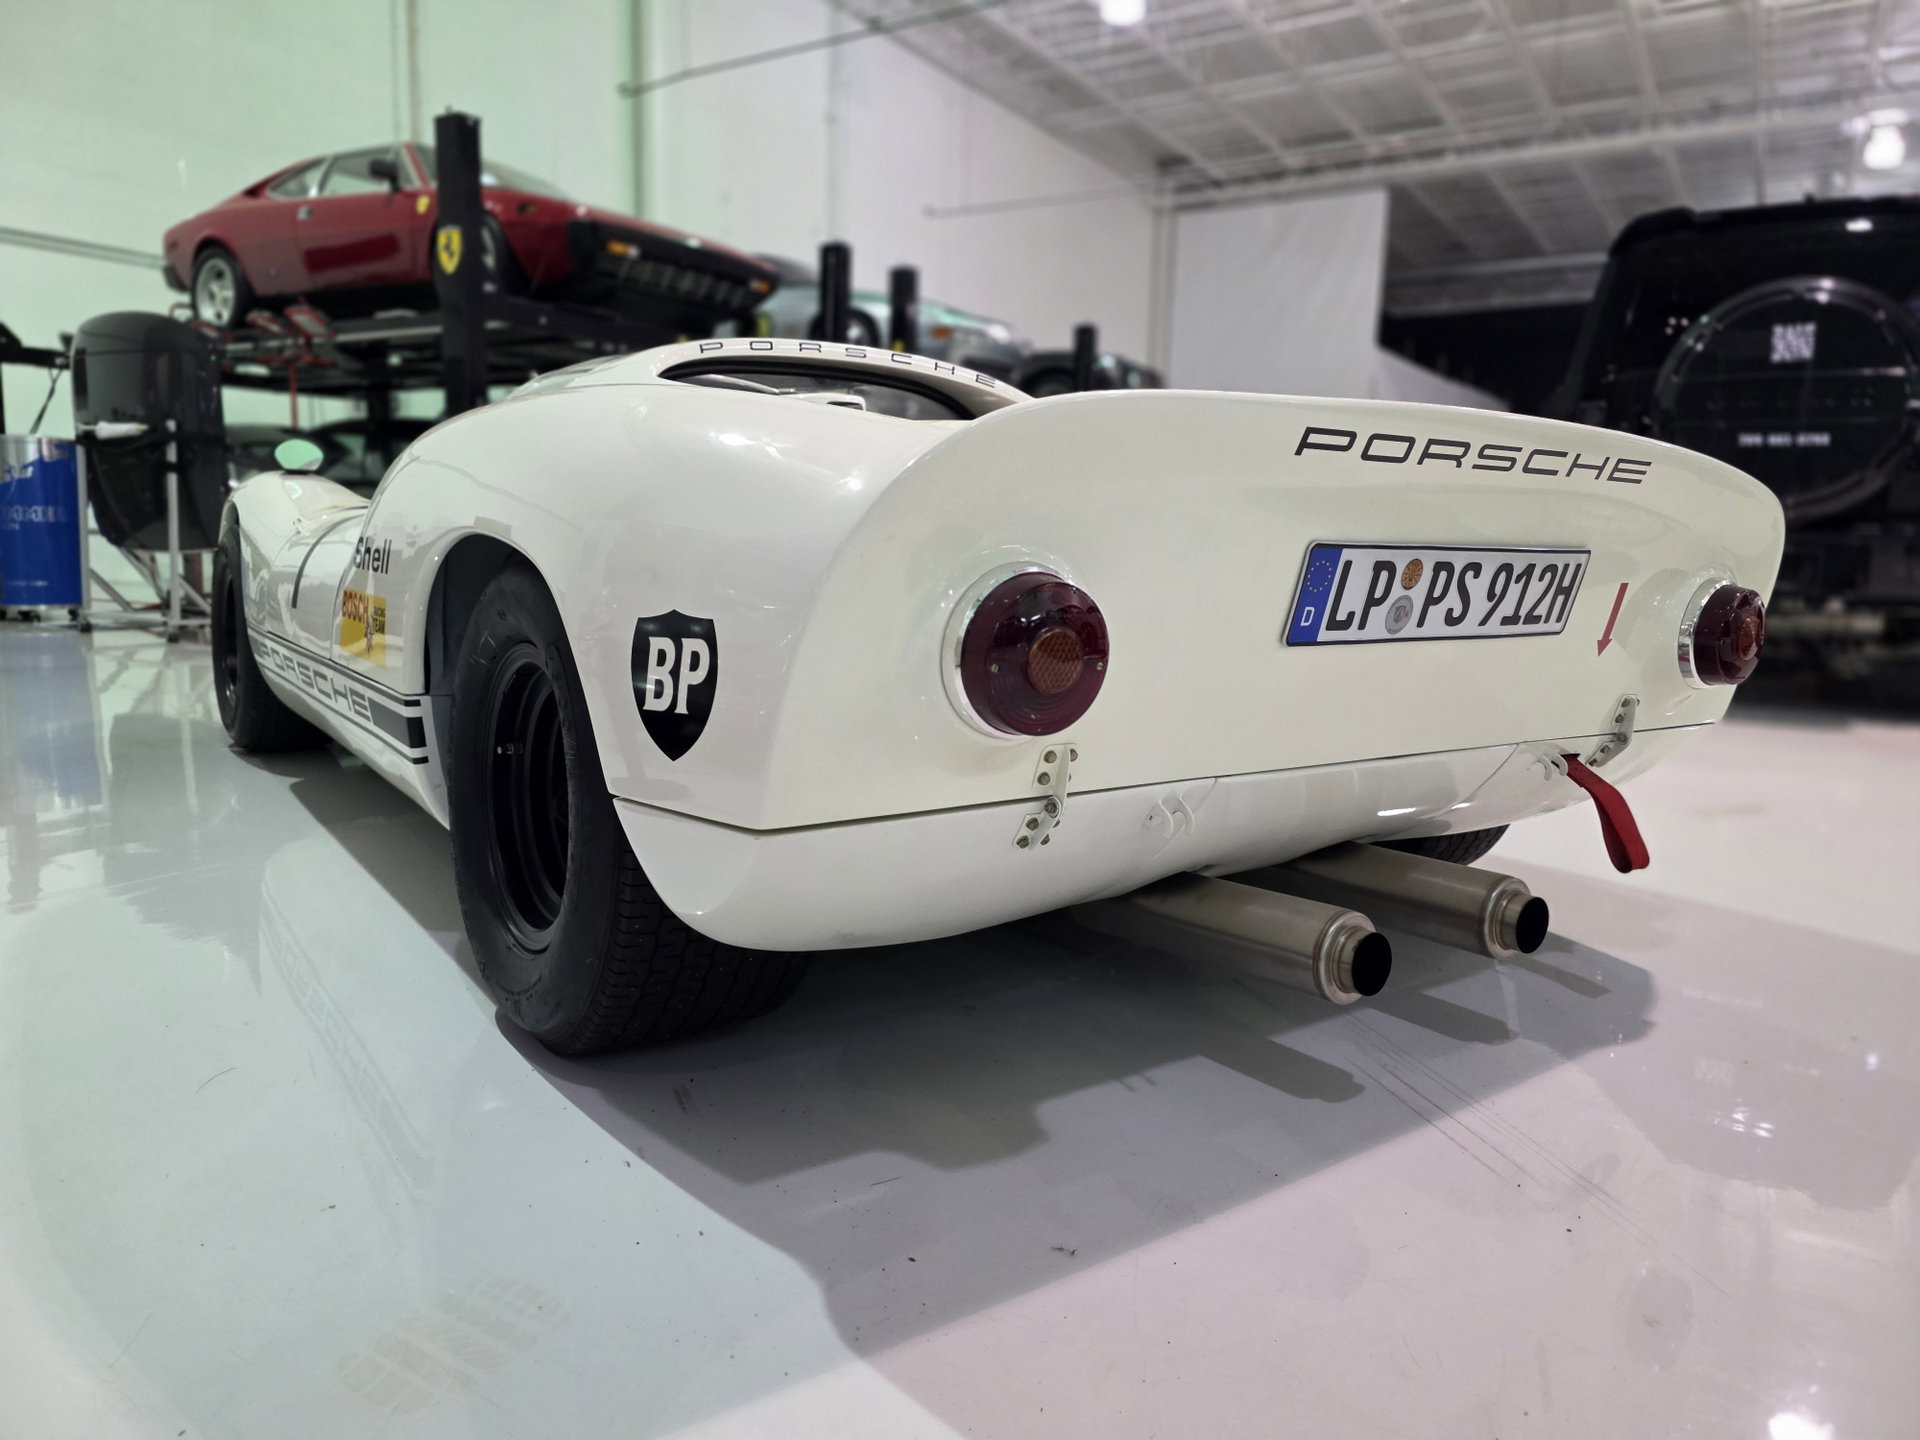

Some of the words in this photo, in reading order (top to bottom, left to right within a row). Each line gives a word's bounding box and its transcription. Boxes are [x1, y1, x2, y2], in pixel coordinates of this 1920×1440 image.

[699, 341, 996, 388] PORSCHE
[1294, 426, 1652, 485] PORSCHE
[353, 536, 392, 575] Shell
[342, 589, 369, 625] BOSCH
[1300, 606, 1316, 627] D
[1325, 560, 1397, 631] LP
[372, 617, 386, 635] TEAM
[256, 640, 371, 722] PORSCHE
[642, 636, 711, 715] BP
